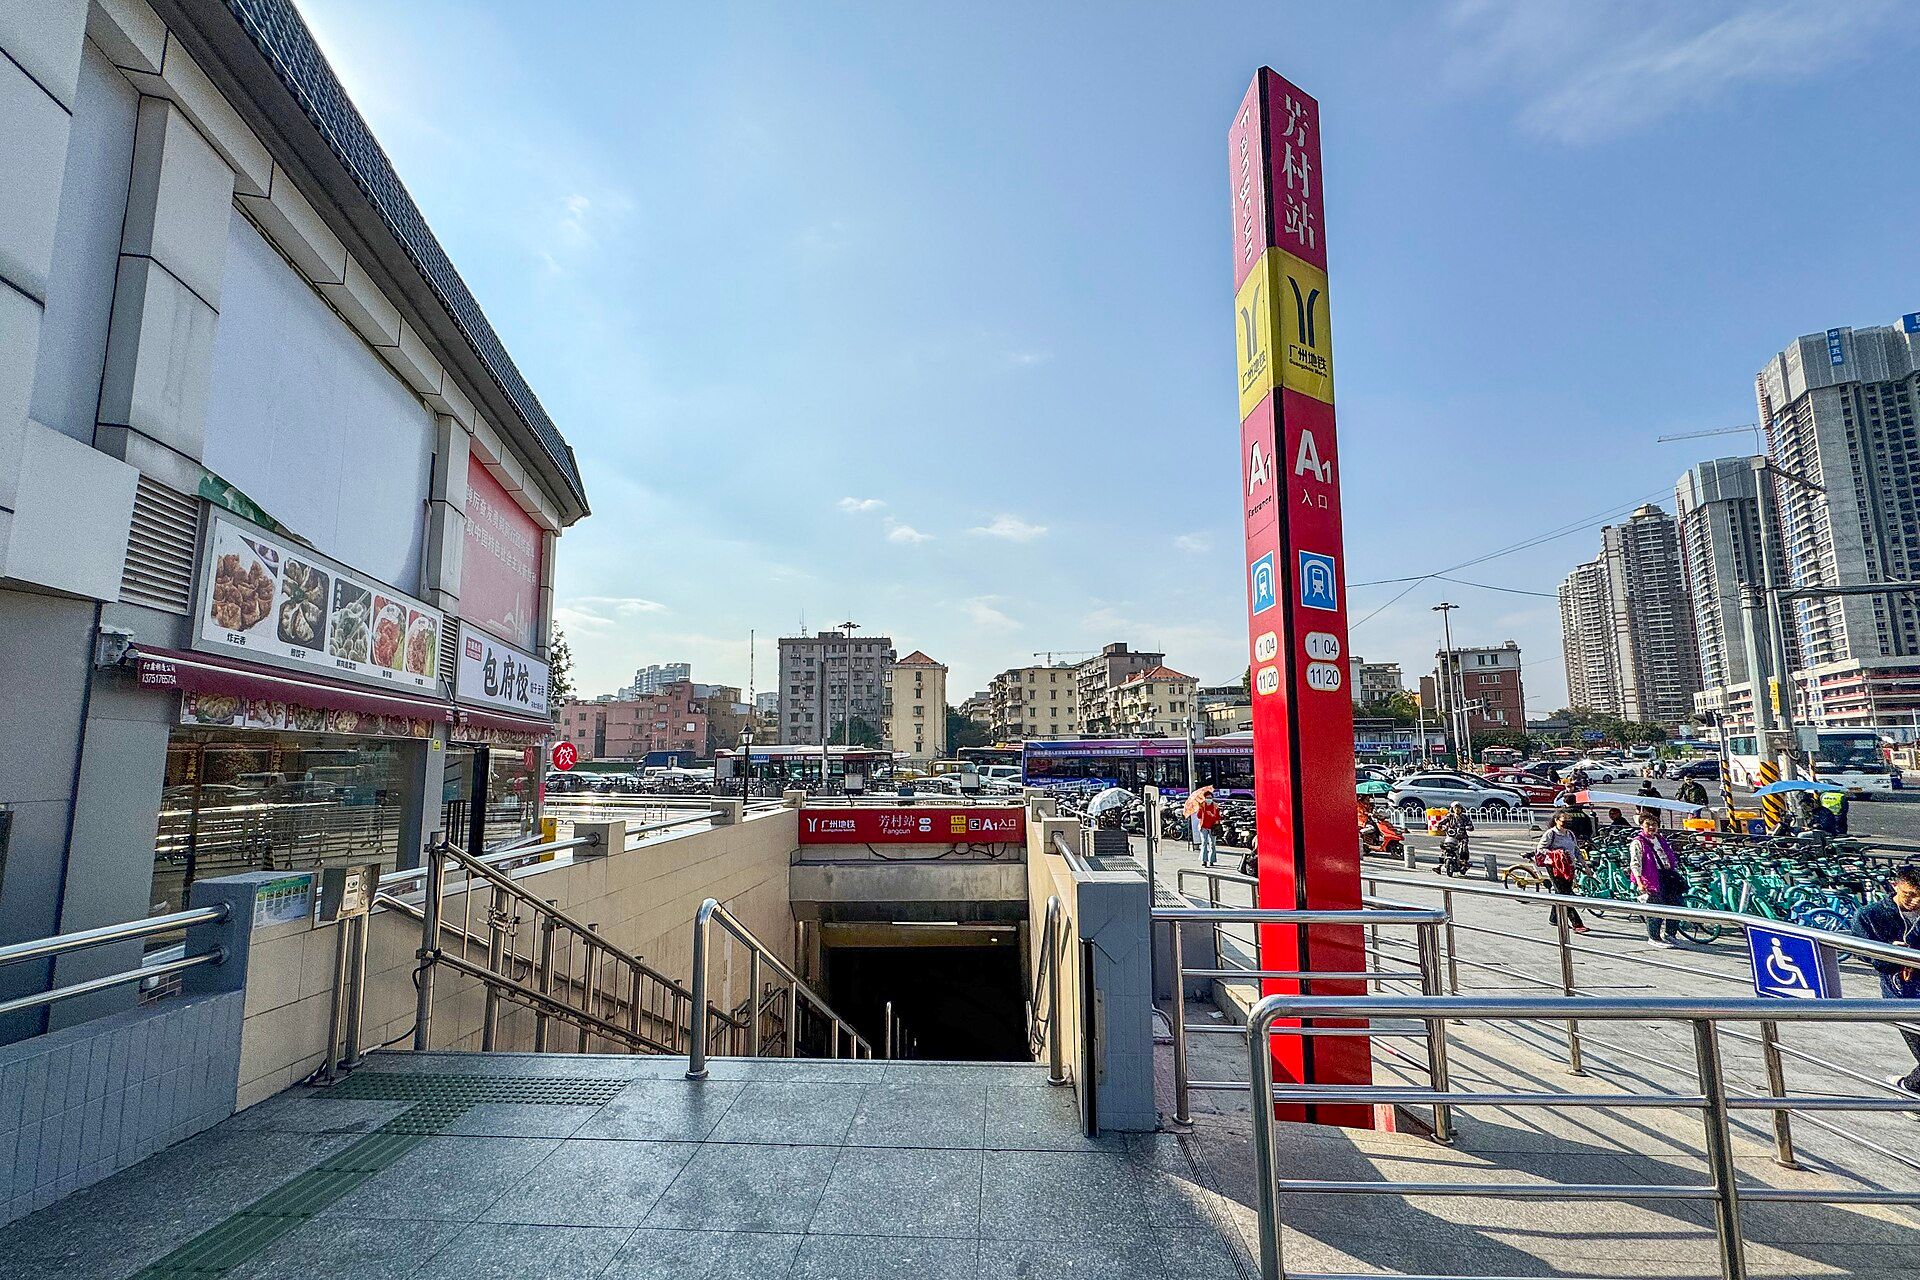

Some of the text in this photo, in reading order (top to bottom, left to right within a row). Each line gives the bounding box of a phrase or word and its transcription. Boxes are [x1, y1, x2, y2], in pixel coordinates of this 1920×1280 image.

[1281, 93, 1315, 250] 芳村站
[1289, 343, 1327, 372] 广州地铁
[1295, 429, 1332, 484] A1
[1248, 440, 1271, 496] A1
[1302, 488, 1328, 510] 入口
[483, 647, 530, 704] 包府饺
[556, 746, 574, 765] 饺
[821, 820, 856, 829] 广州地铁
[879, 815, 916, 828] 芳村站
[882, 827, 911, 836] Fangcun
[982, 818, 998, 831] A1
[999, 818, 1017, 827] 入口
